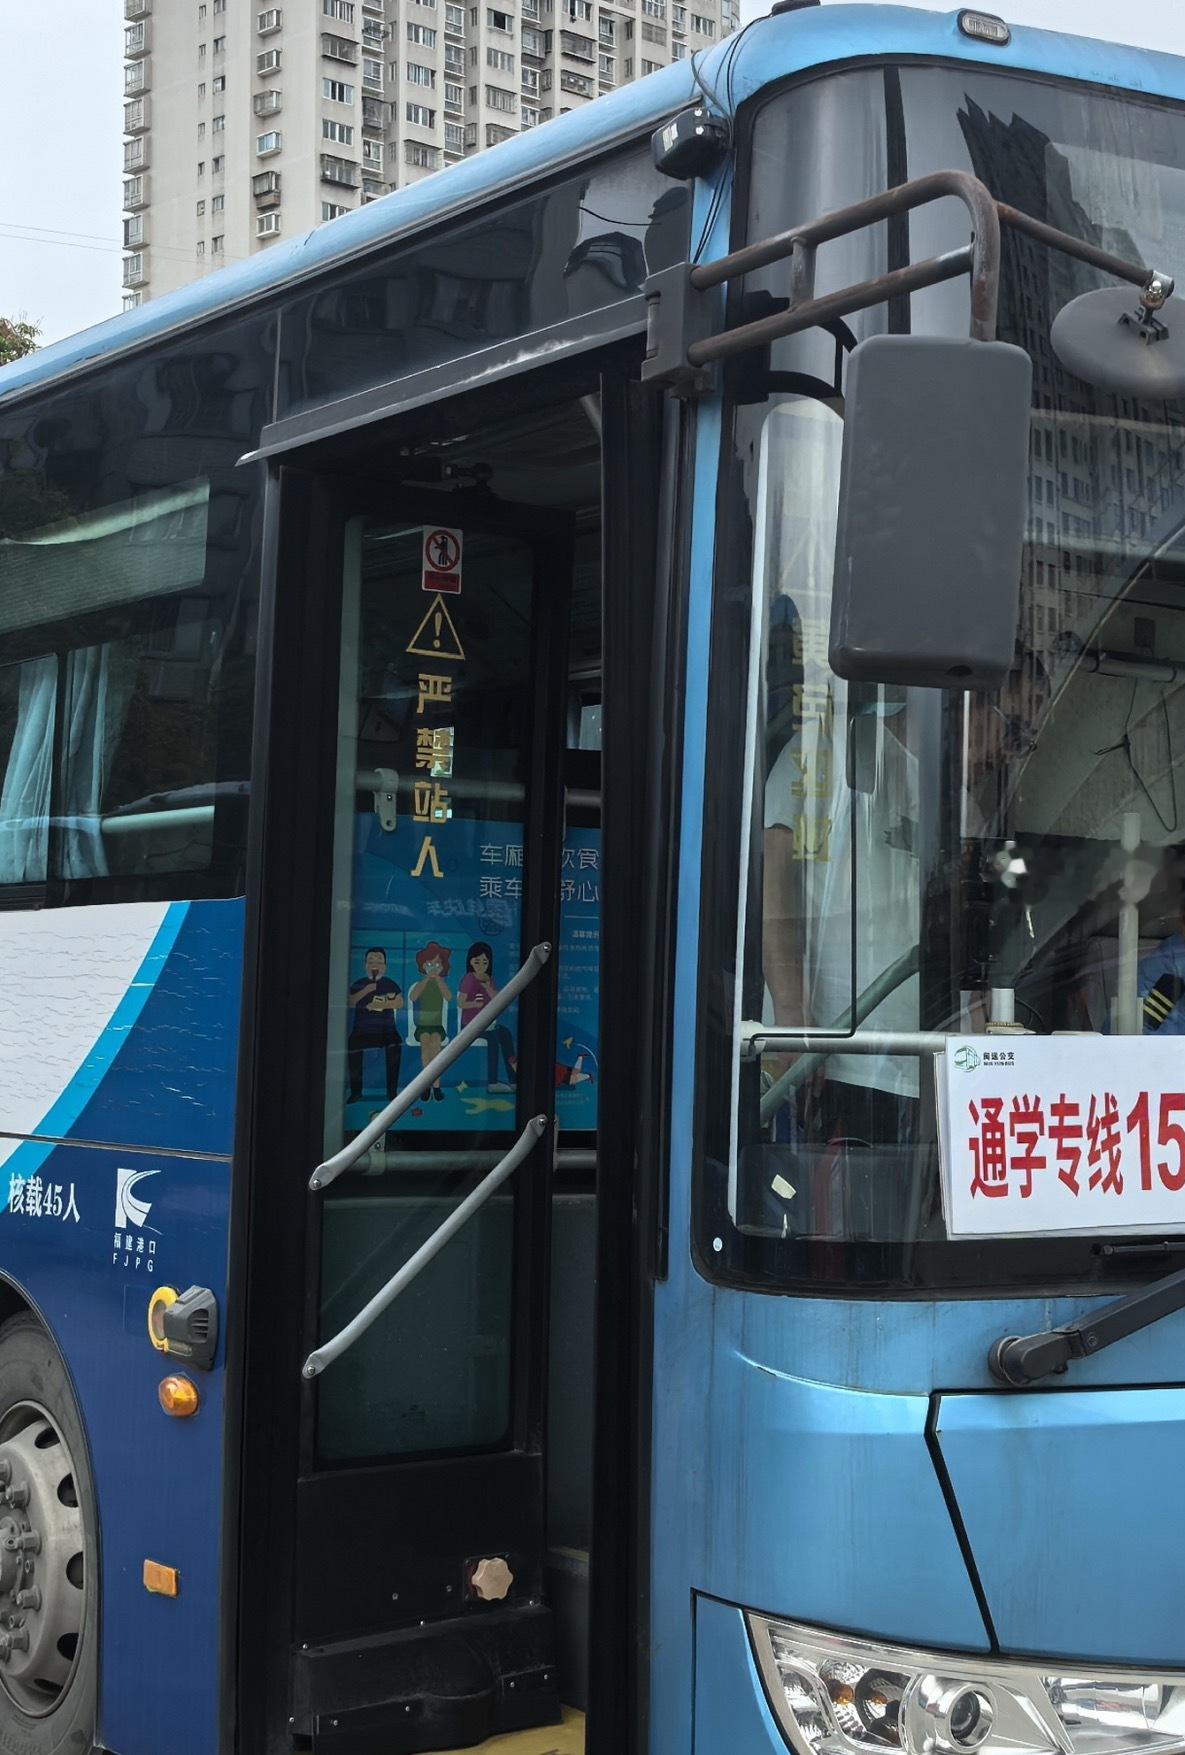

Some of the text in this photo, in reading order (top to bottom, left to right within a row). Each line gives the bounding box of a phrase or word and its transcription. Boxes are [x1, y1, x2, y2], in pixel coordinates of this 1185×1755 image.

[411, 673, 453, 877] 严禁站人
[8, 1173, 81, 1223] 核载45人
[113, 1232, 157, 1255] 福建港口
[112, 1252, 154, 1272] FJPG
